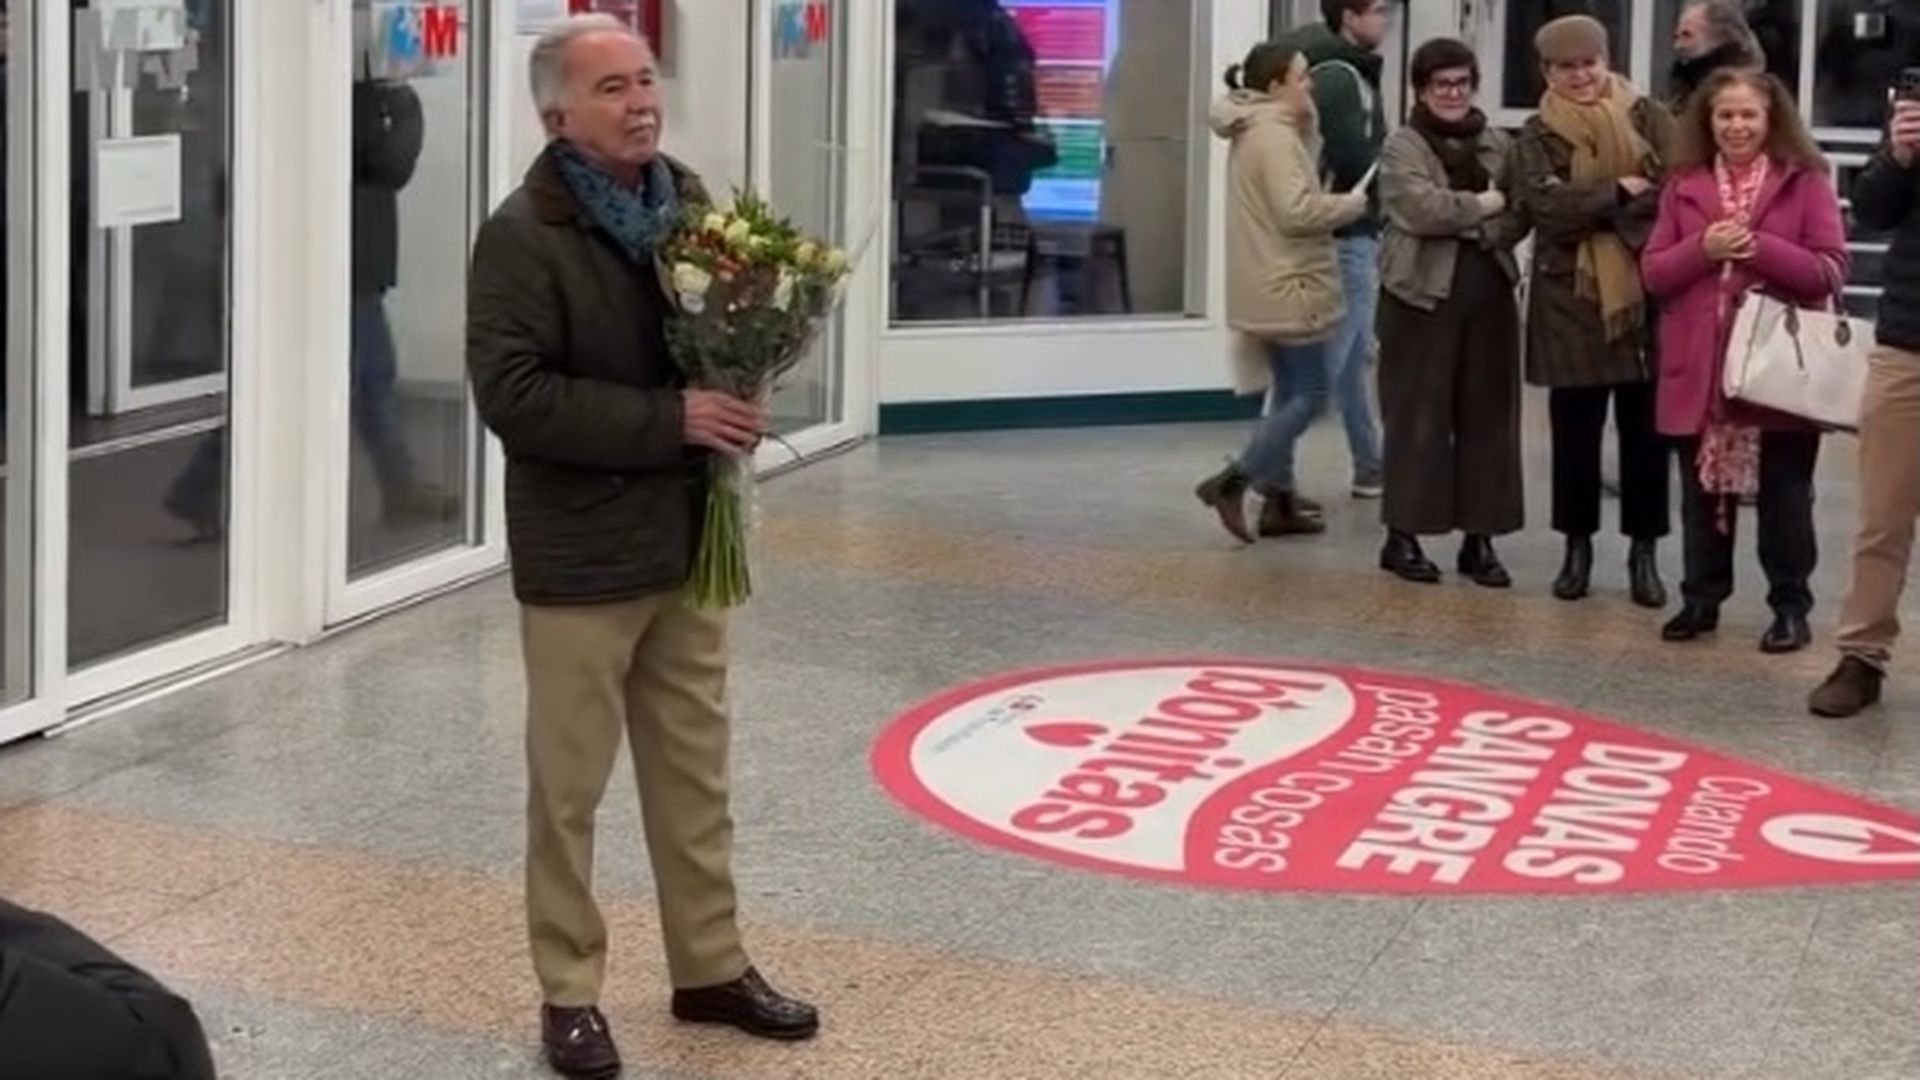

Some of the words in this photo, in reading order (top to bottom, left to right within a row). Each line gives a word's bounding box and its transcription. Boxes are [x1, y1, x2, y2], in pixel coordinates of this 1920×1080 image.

[424, 6, 458, 57] M
[1010, 669, 1326, 840] bonitas
[1319, 683, 1440, 774] pasan
[1213, 770, 1352, 873] cosas
[1336, 711, 1573, 883] SANGRE
[1502, 742, 1689, 883] DONAS
[1657, 775, 1771, 873] Cuando
